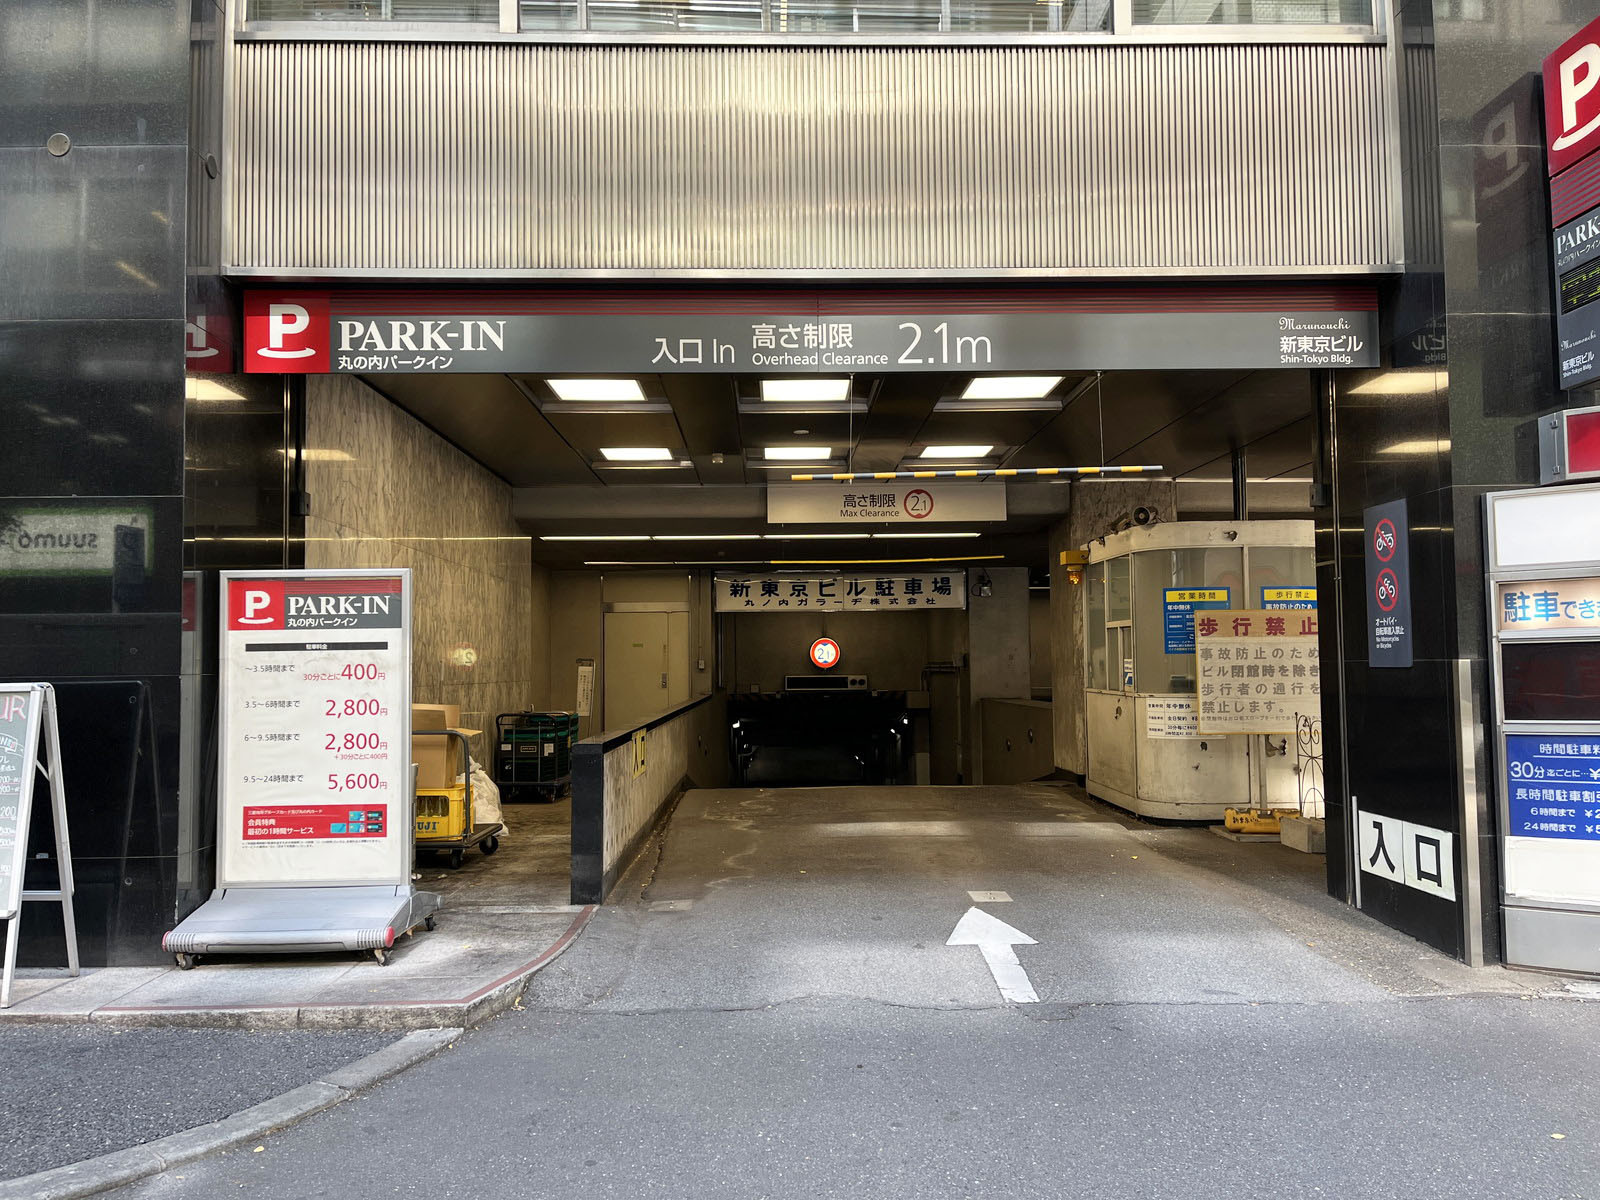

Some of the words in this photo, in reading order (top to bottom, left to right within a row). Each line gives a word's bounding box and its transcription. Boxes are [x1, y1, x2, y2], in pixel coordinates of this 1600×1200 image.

[270, 304, 310, 348] P
[1279, 316, 1350, 331] Marunouchi
[337, 320, 507, 352] PARK-IN
[752, 323, 853, 349] 高さ制限
[898, 322, 992, 365] 2.1m
[1280, 335, 1363, 353] 新東京ビル
[651, 337, 702, 364] 入口
[713, 339, 735, 364] In
[752, 352, 819, 366] Overhead
[822, 352, 889, 366] Clearance
[338, 355, 454, 370] 丸の内パークイン
[1280, 354, 1329, 365] Shin-Tokyo
[1330, 354, 1354, 365] Bldg.
[843, 494, 896, 508] 高さ制限
[911, 495, 928, 511] 2.1
[840, 509, 858, 518] Max
[859, 508, 900, 518] Clearance
[729, 576, 953, 598] 新東京ビル駐車場
[1276, 591, 1310, 599] 歩行禁止
[245, 590, 271, 618] P
[1177, 592, 1216, 601] 営業時間
[287, 595, 391, 616] PARK-IN
[1504, 589, 1600, 623] 駐車でき
[287, 617, 358, 628] 丸の内パークイン
[1198, 616, 1318, 637] 歩行禁止
[1200, 646, 1319, 661] 事故防止のため
[1202, 664, 1320, 679] ビル閉館時を除き
[1201, 682, 1320, 697] 歩行者の通行を
[325, 698, 388, 719] 2,800円
[1201, 700, 1284, 715] 禁止します。
[325, 732, 388, 753] 2,800円
[328, 772, 388, 793] 5,600円
[1530, 806, 1576, 818] 6時間まで
[1523, 821, 1577, 833] 24時間まで
[1369, 820, 1442, 888] 入口
